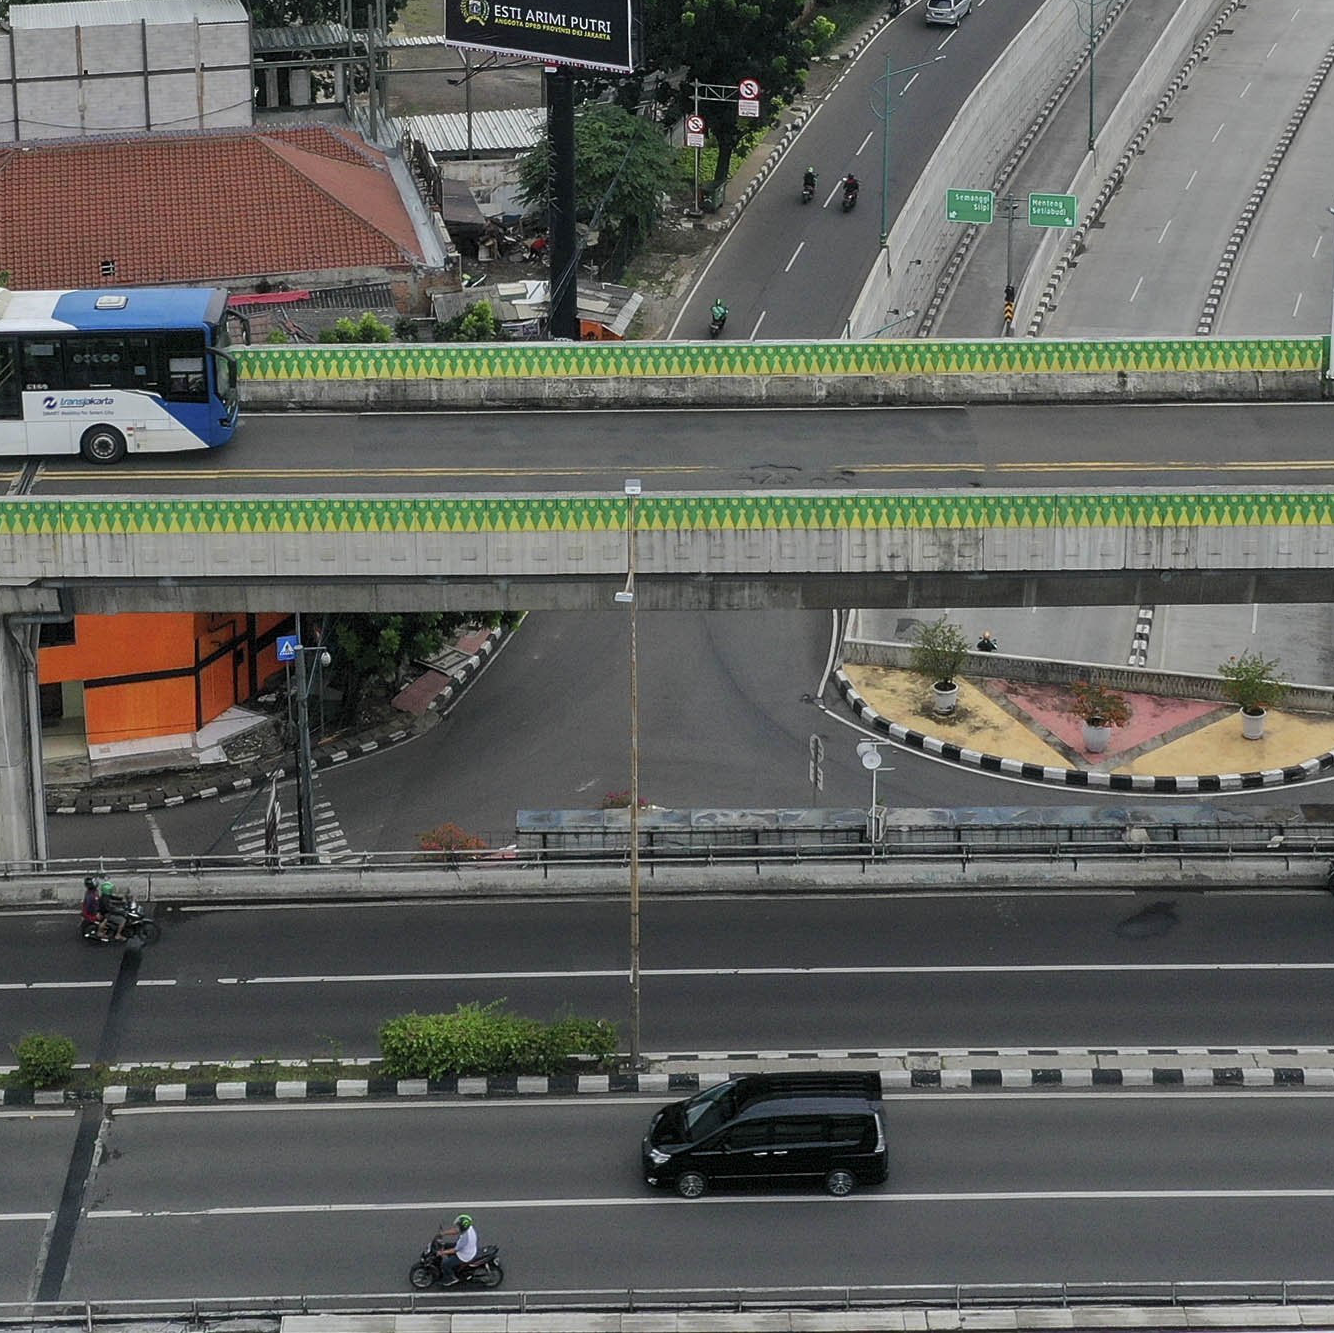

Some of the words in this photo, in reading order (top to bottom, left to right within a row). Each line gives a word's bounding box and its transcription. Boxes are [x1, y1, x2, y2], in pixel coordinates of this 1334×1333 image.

[494, 4, 522, 20] ESTI
[525, 9, 567, 27] ARIMI
[570, 16, 612, 34] PUTRI
[955, 193, 990, 203] Semanggi
[1032, 199, 1063, 209] Menteng
[1032, 207, 1066, 216] Setiabudi
[60, 396, 115, 408] transjakarta
